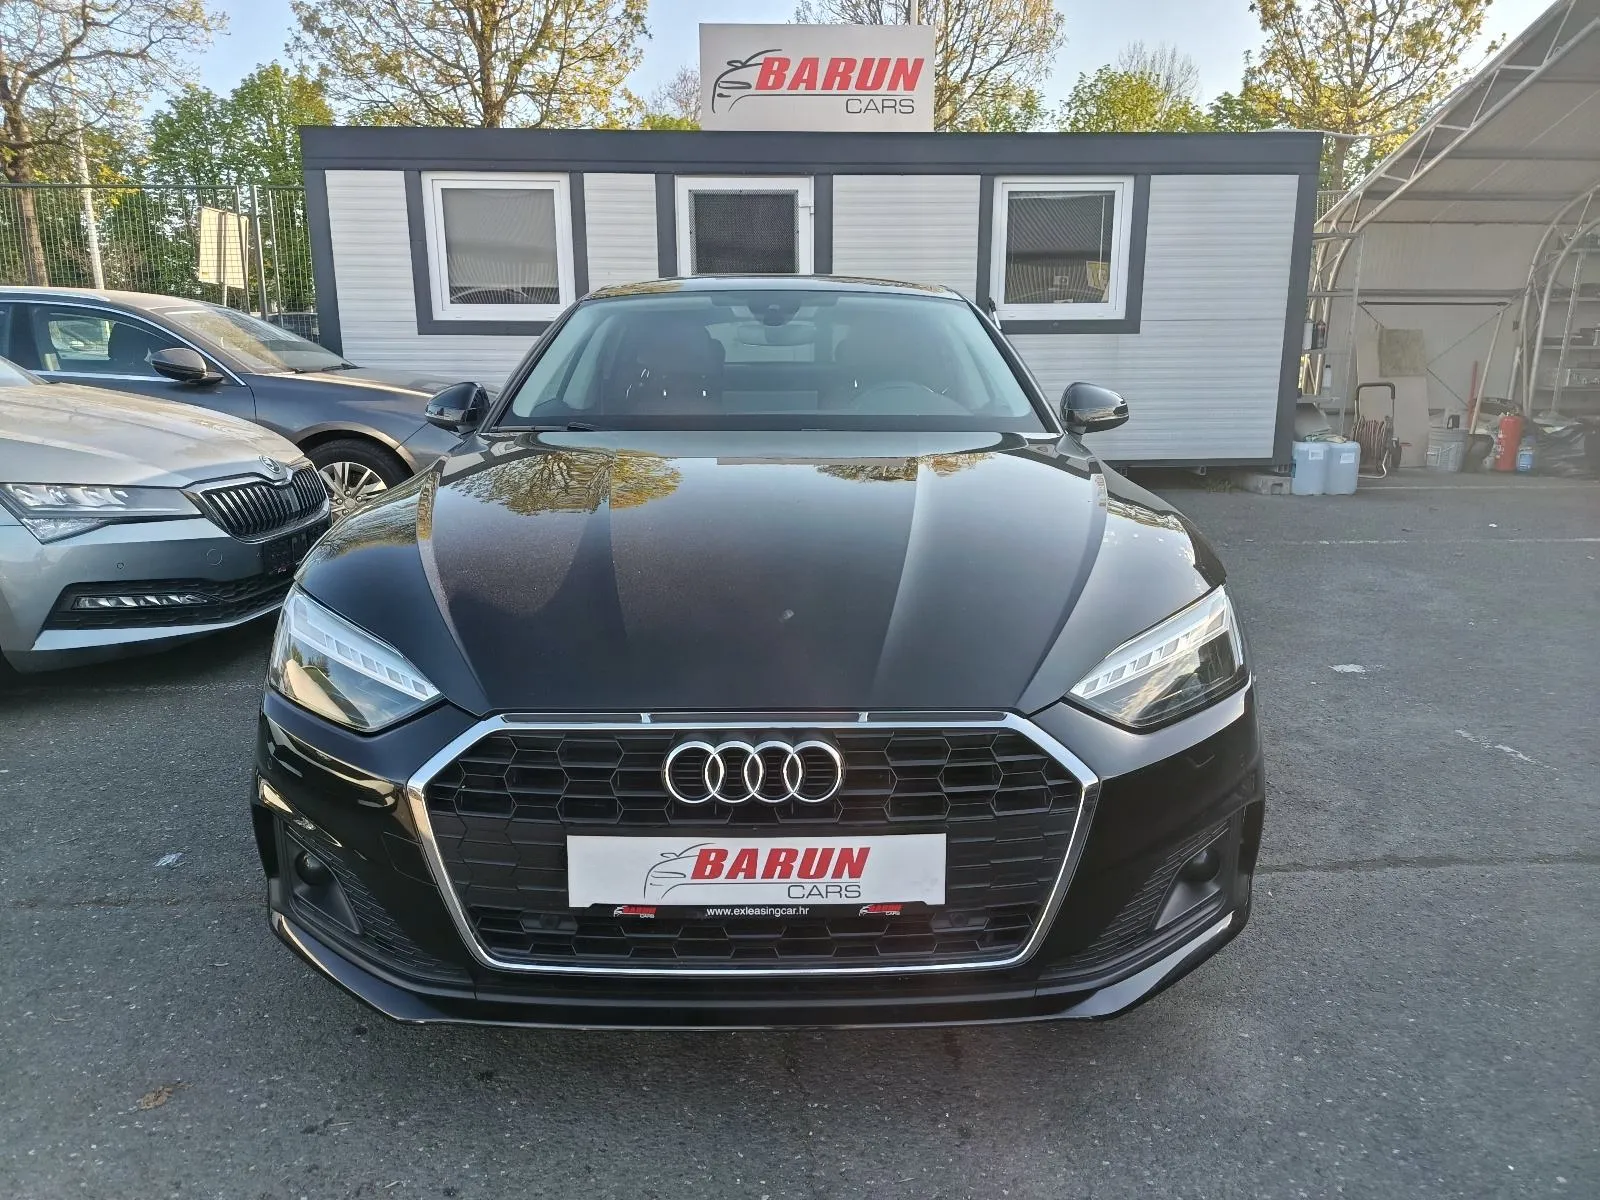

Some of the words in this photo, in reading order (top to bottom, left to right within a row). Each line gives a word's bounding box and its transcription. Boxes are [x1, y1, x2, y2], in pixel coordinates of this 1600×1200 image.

[755, 56, 924, 91] BARUN
[846, 99, 915, 114] CARS
[691, 847, 870, 880] BARUN
[787, 885, 861, 899] CARS
[706, 906, 809, 917] www.exleasingcar.hr
